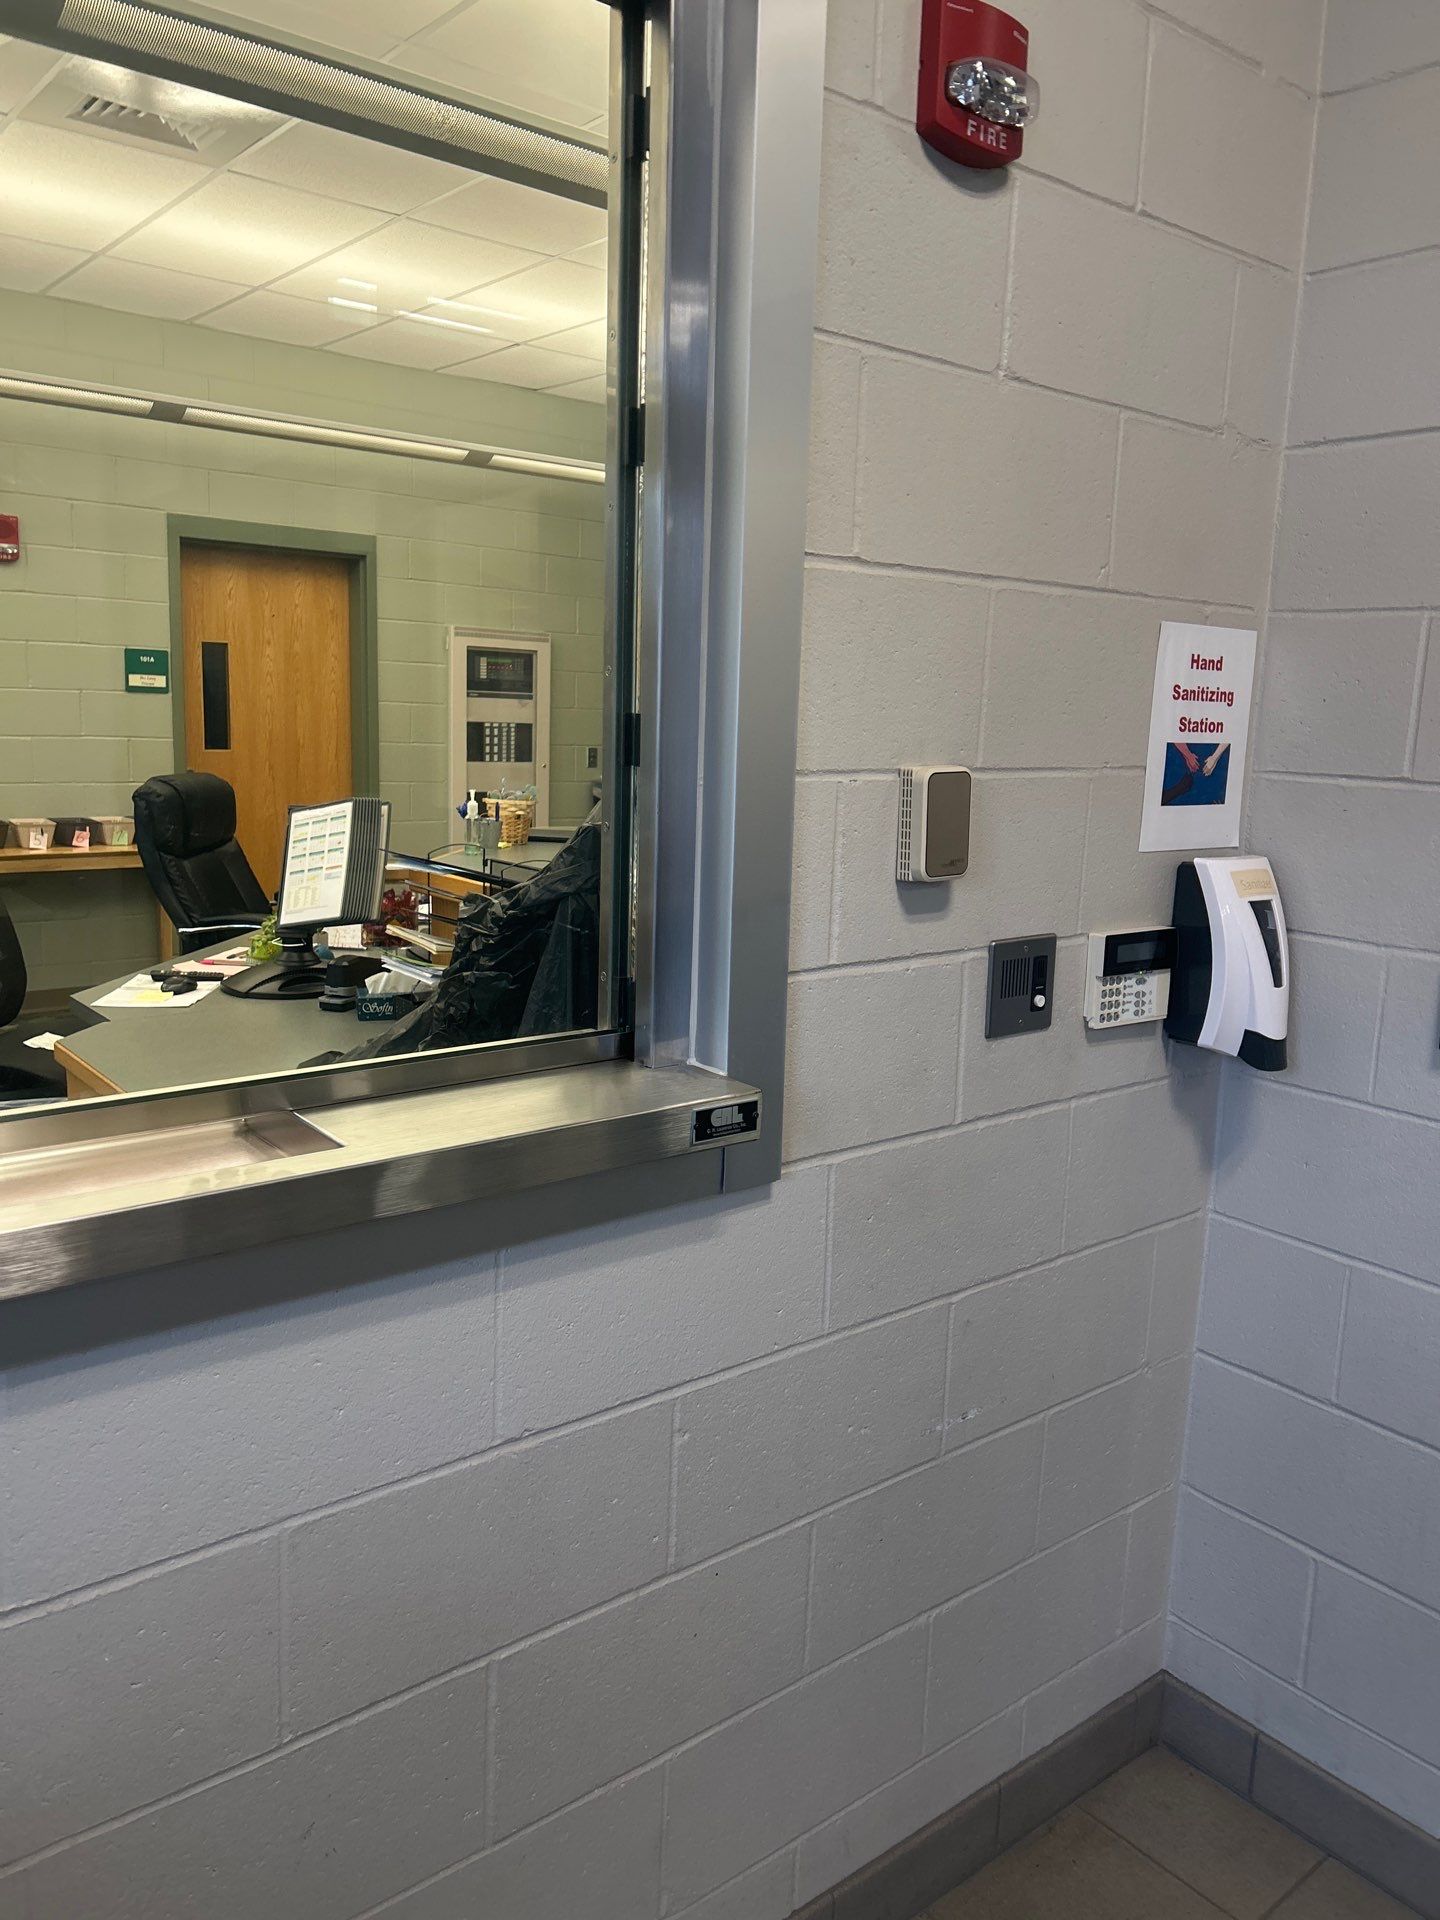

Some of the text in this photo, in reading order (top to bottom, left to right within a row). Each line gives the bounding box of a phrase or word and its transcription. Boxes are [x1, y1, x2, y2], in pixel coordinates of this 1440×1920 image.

[967, 119, 1008, 150] FIRE
[1190, 653, 1224, 671] Hand
[1172, 684, 1235, 707] Sanitizing
[1178, 716, 1224, 734] Station
